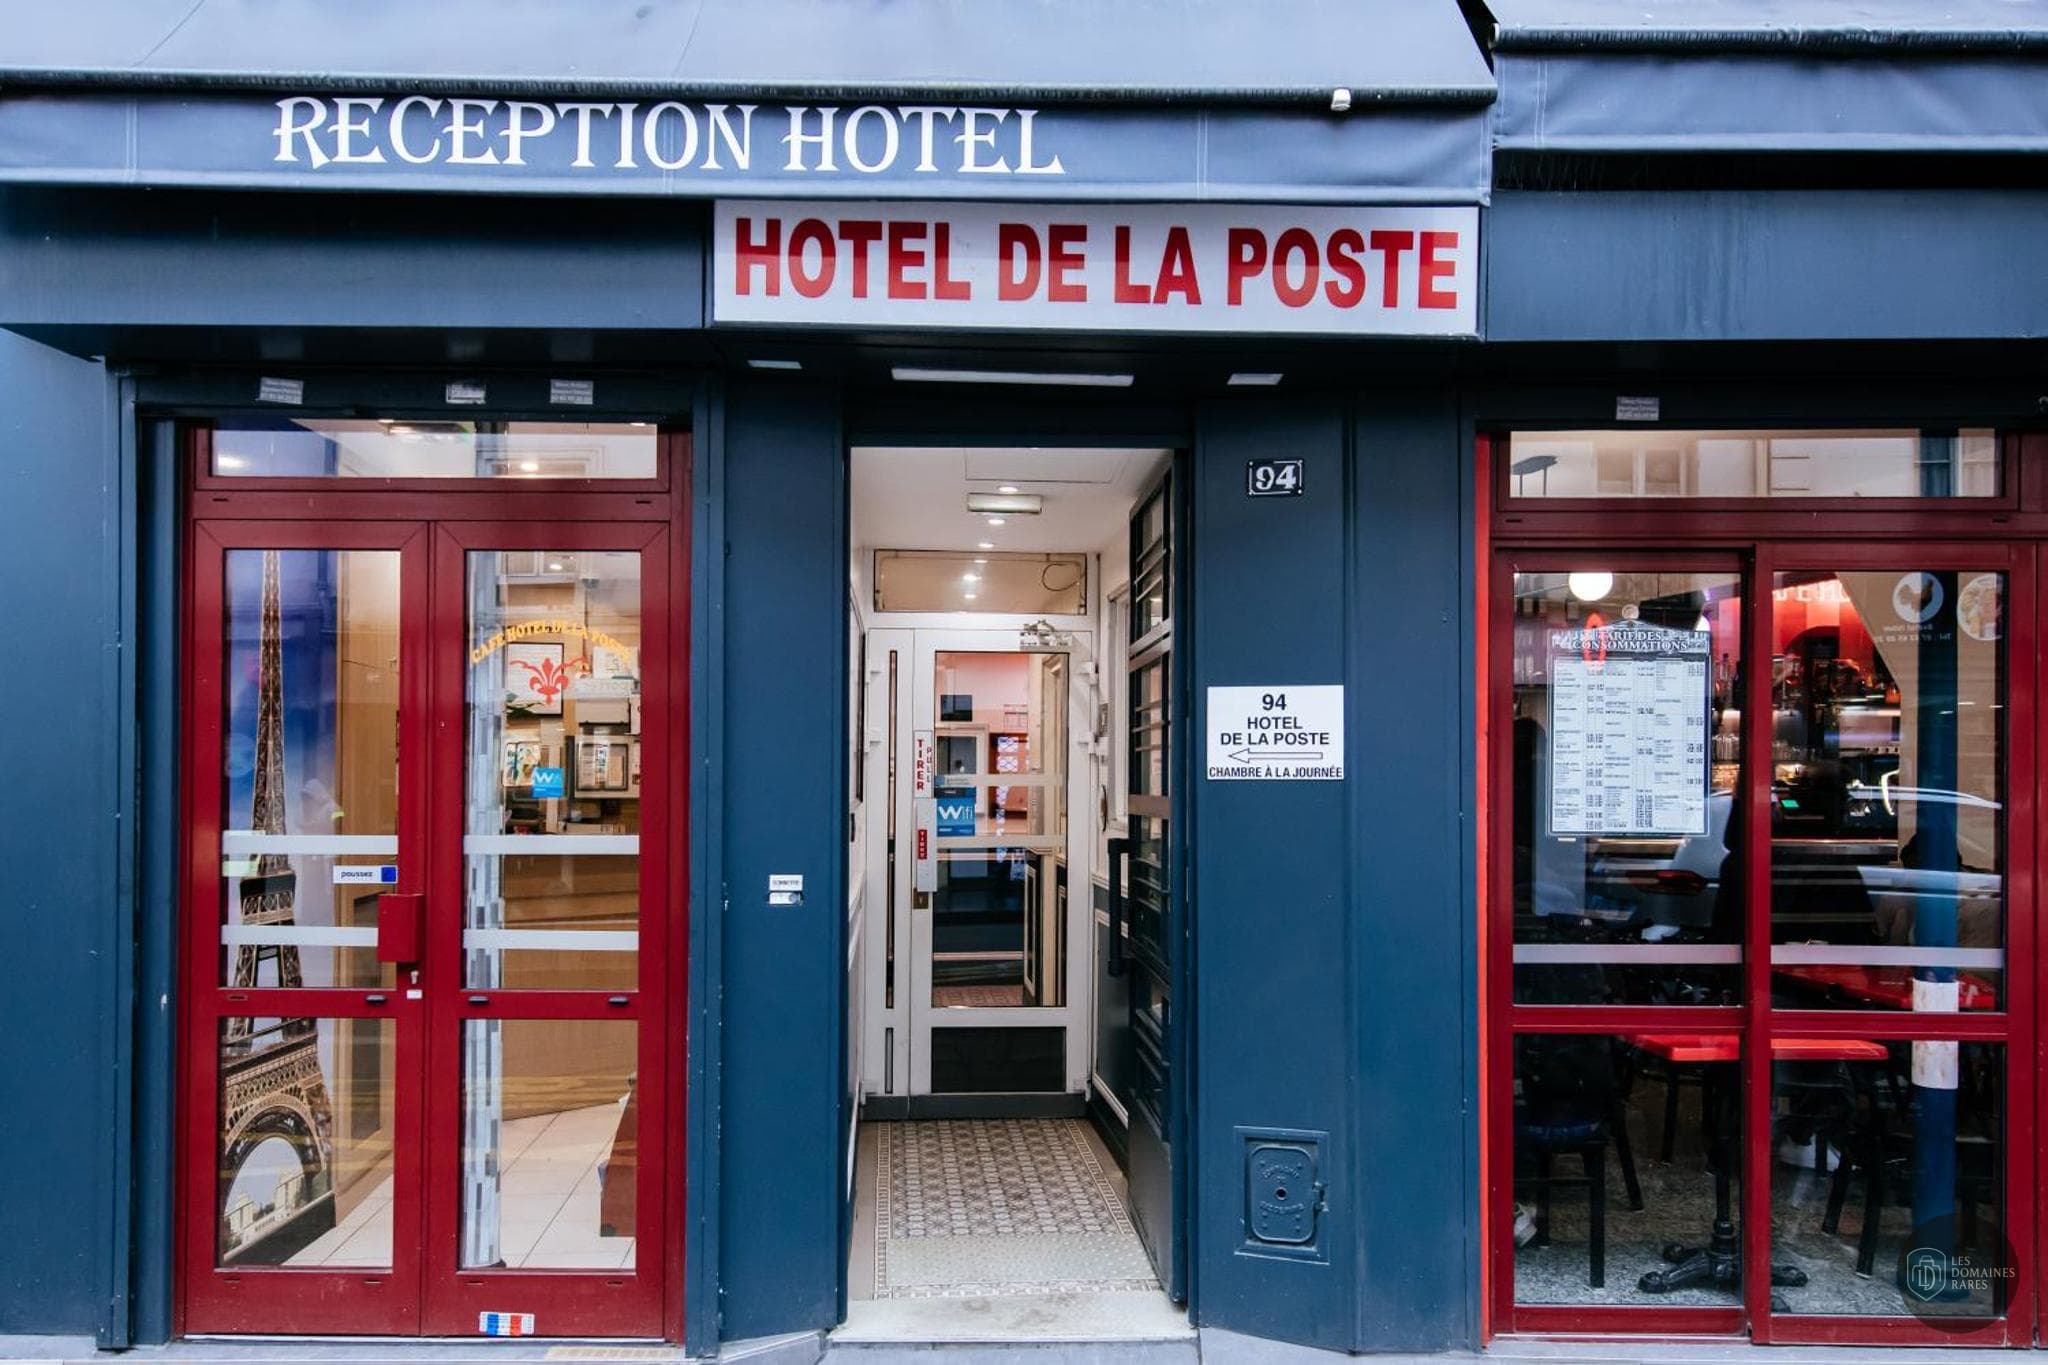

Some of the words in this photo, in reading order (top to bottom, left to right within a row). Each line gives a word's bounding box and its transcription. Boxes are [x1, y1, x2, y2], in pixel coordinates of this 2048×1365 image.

[273, 96, 759, 170] RECEPTION
[781, 105, 1066, 175] HOTEL
[735, 217, 971, 301] HOTEL
[998, 222, 1088, 303] DE
[1115, 225, 1202, 305] LA
[1227, 227, 1460, 310] POSTE
[1255, 465, 1297, 491] 94
[1637, 631, 1662, 641] DES
[1572, 640, 1689, 651] CONSOMMATIONS
[1262, 693, 1287, 711] 94
[1247, 716, 1303, 730] HOTEL
[1220, 732, 1242, 745] DE
[1248, 732, 1269, 745] LA
[1274, 732, 1330, 745] POSTE
[916, 739, 924, 791] TIRER
[1209, 766, 1262, 778] CHAMBRE
[1264, 764, 1272, 778] À
[1275, 767, 1290, 778] LA
[1293, 764, 1342, 778] JOURNÉE
